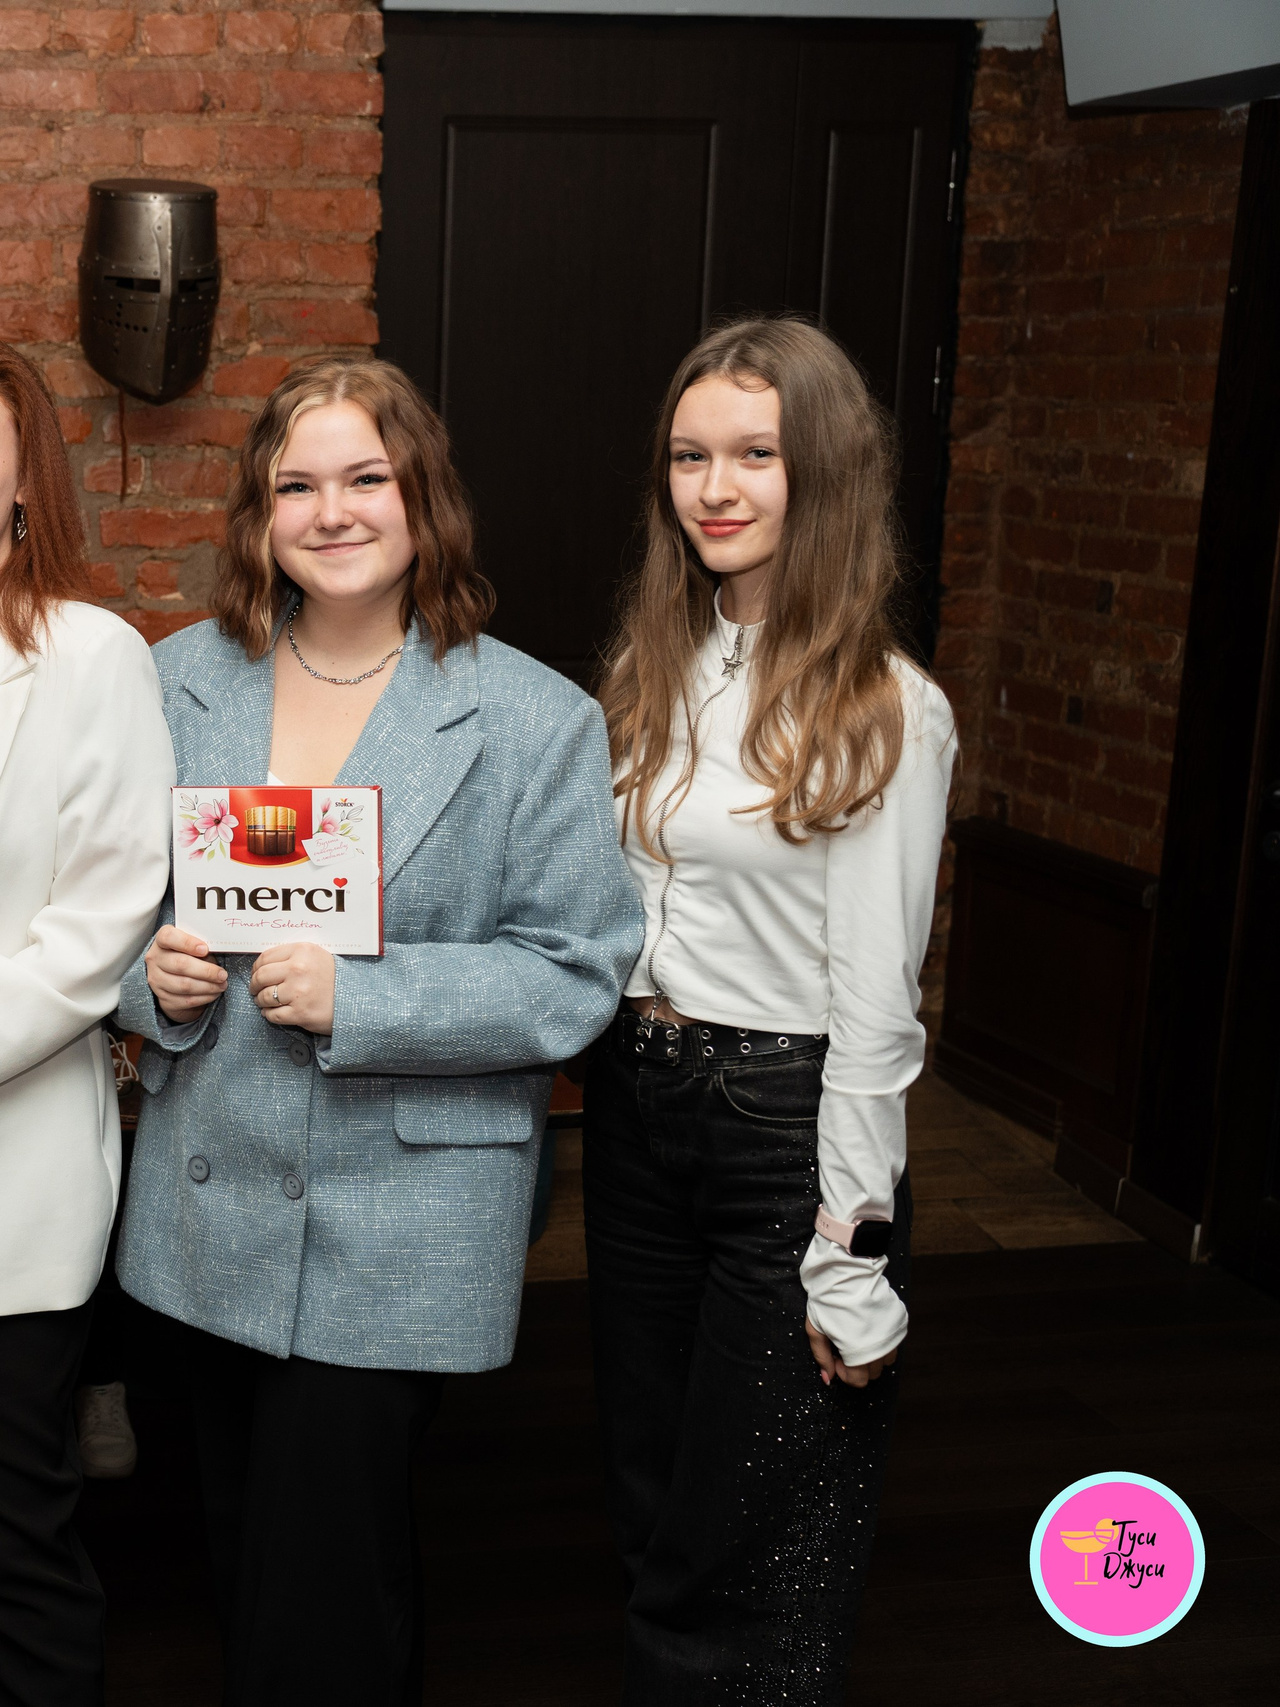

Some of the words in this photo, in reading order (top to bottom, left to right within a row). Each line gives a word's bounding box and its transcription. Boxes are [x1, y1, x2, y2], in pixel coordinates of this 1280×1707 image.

[196, 877, 348, 912] merci
[224, 918, 271, 929] Finest
[270, 918, 323, 929] Selection
